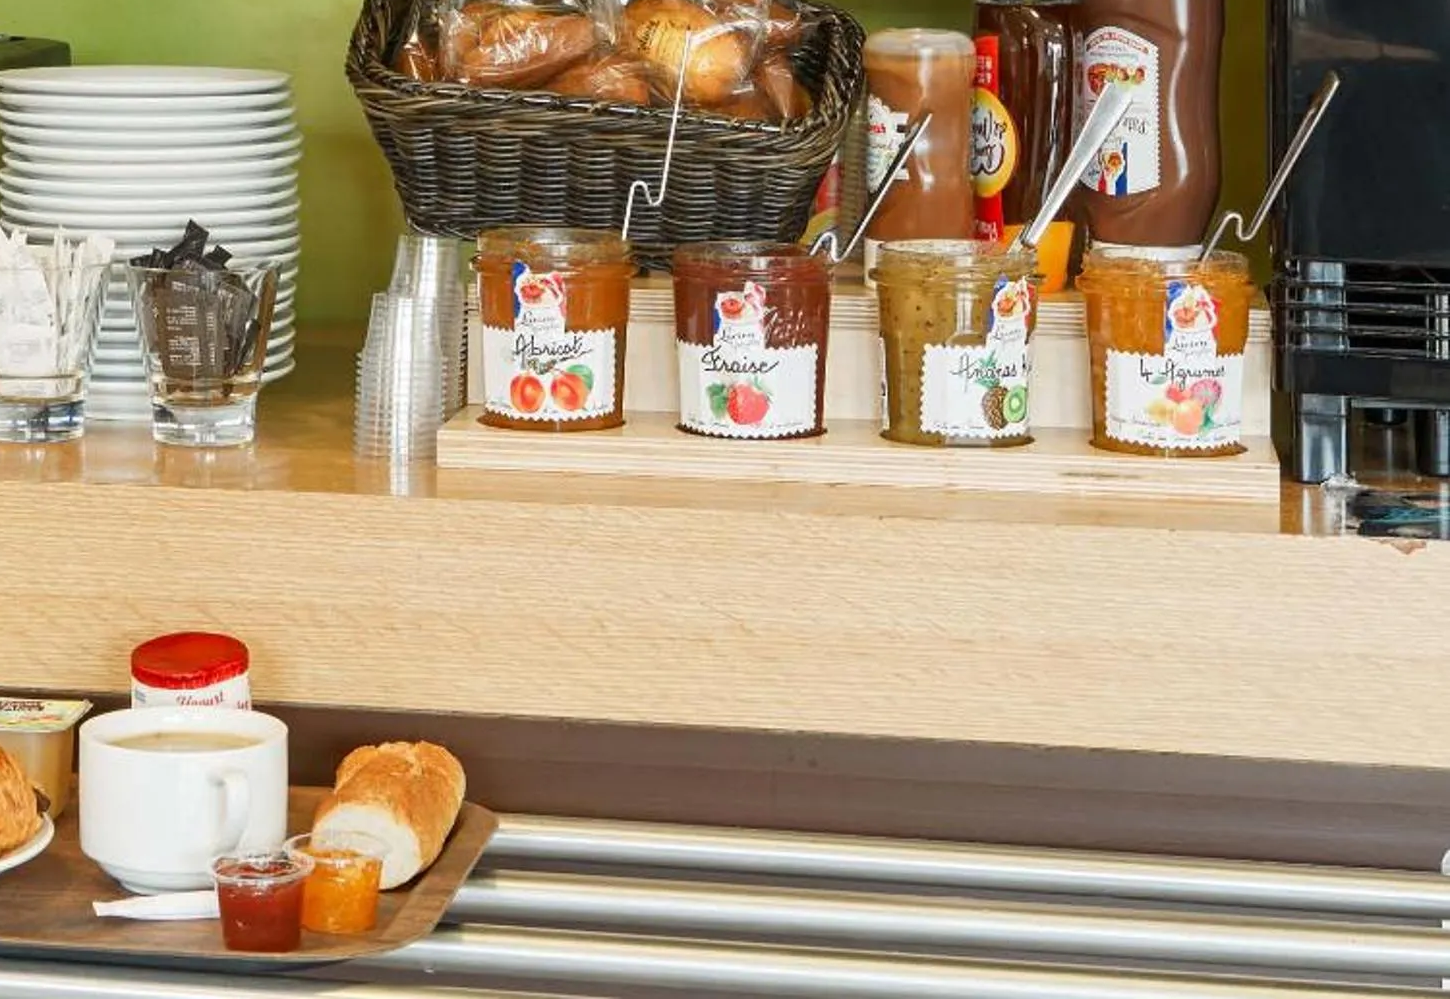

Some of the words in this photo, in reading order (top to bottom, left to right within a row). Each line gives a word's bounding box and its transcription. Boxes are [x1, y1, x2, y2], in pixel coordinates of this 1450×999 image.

[513, 333, 586, 369] Abricot
[701, 345, 779, 373] Fraise
[950, 351, 1018, 393] Ananas
[1139, 358, 1153, 382] 4
